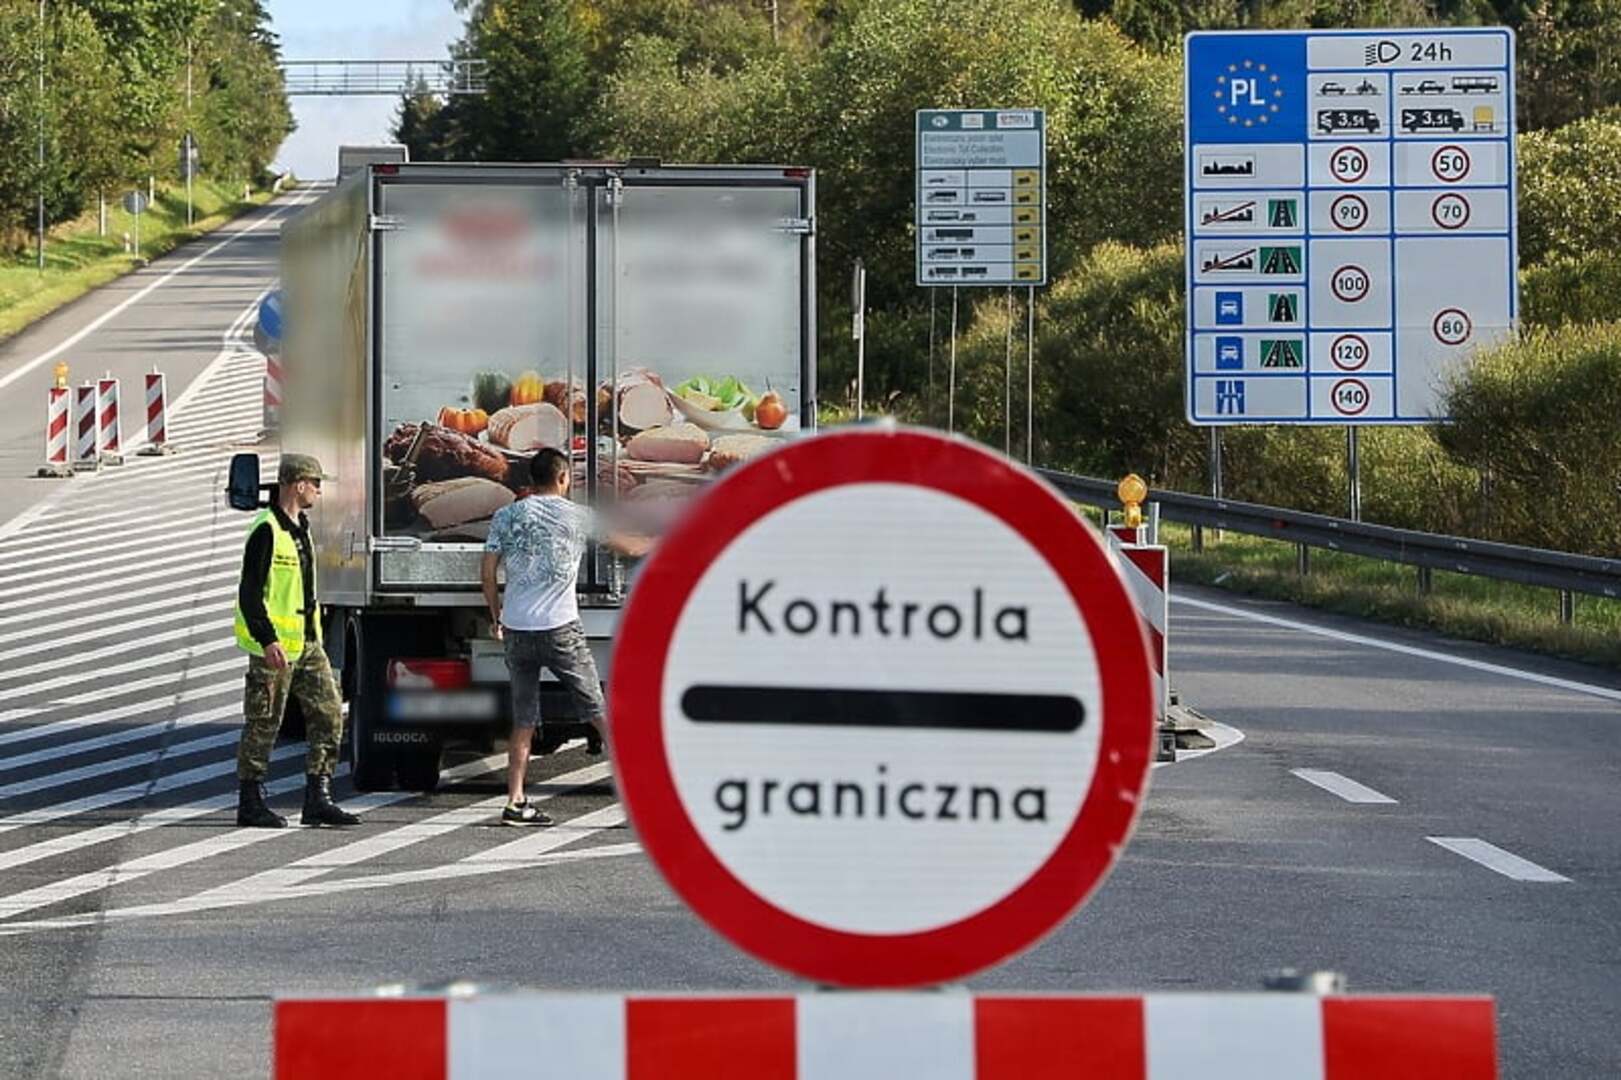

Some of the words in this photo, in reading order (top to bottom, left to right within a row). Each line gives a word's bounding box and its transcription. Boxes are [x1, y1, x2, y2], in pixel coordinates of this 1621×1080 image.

[1410, 41, 1452, 62] 24h
[1231, 78, 1266, 105] PL
[1337, 156, 1362, 173] 50
[1439, 155, 1464, 172] 50
[1340, 206, 1360, 221] 90
[1442, 205, 1462, 219] 70
[1338, 276, 1364, 291] 100
[1442, 320, 1463, 335] 80
[1338, 346, 1363, 360] 120
[1338, 390, 1363, 404] 140
[737, 579, 1030, 642] Kontrola
[714, 763, 1048, 831] graniczna
